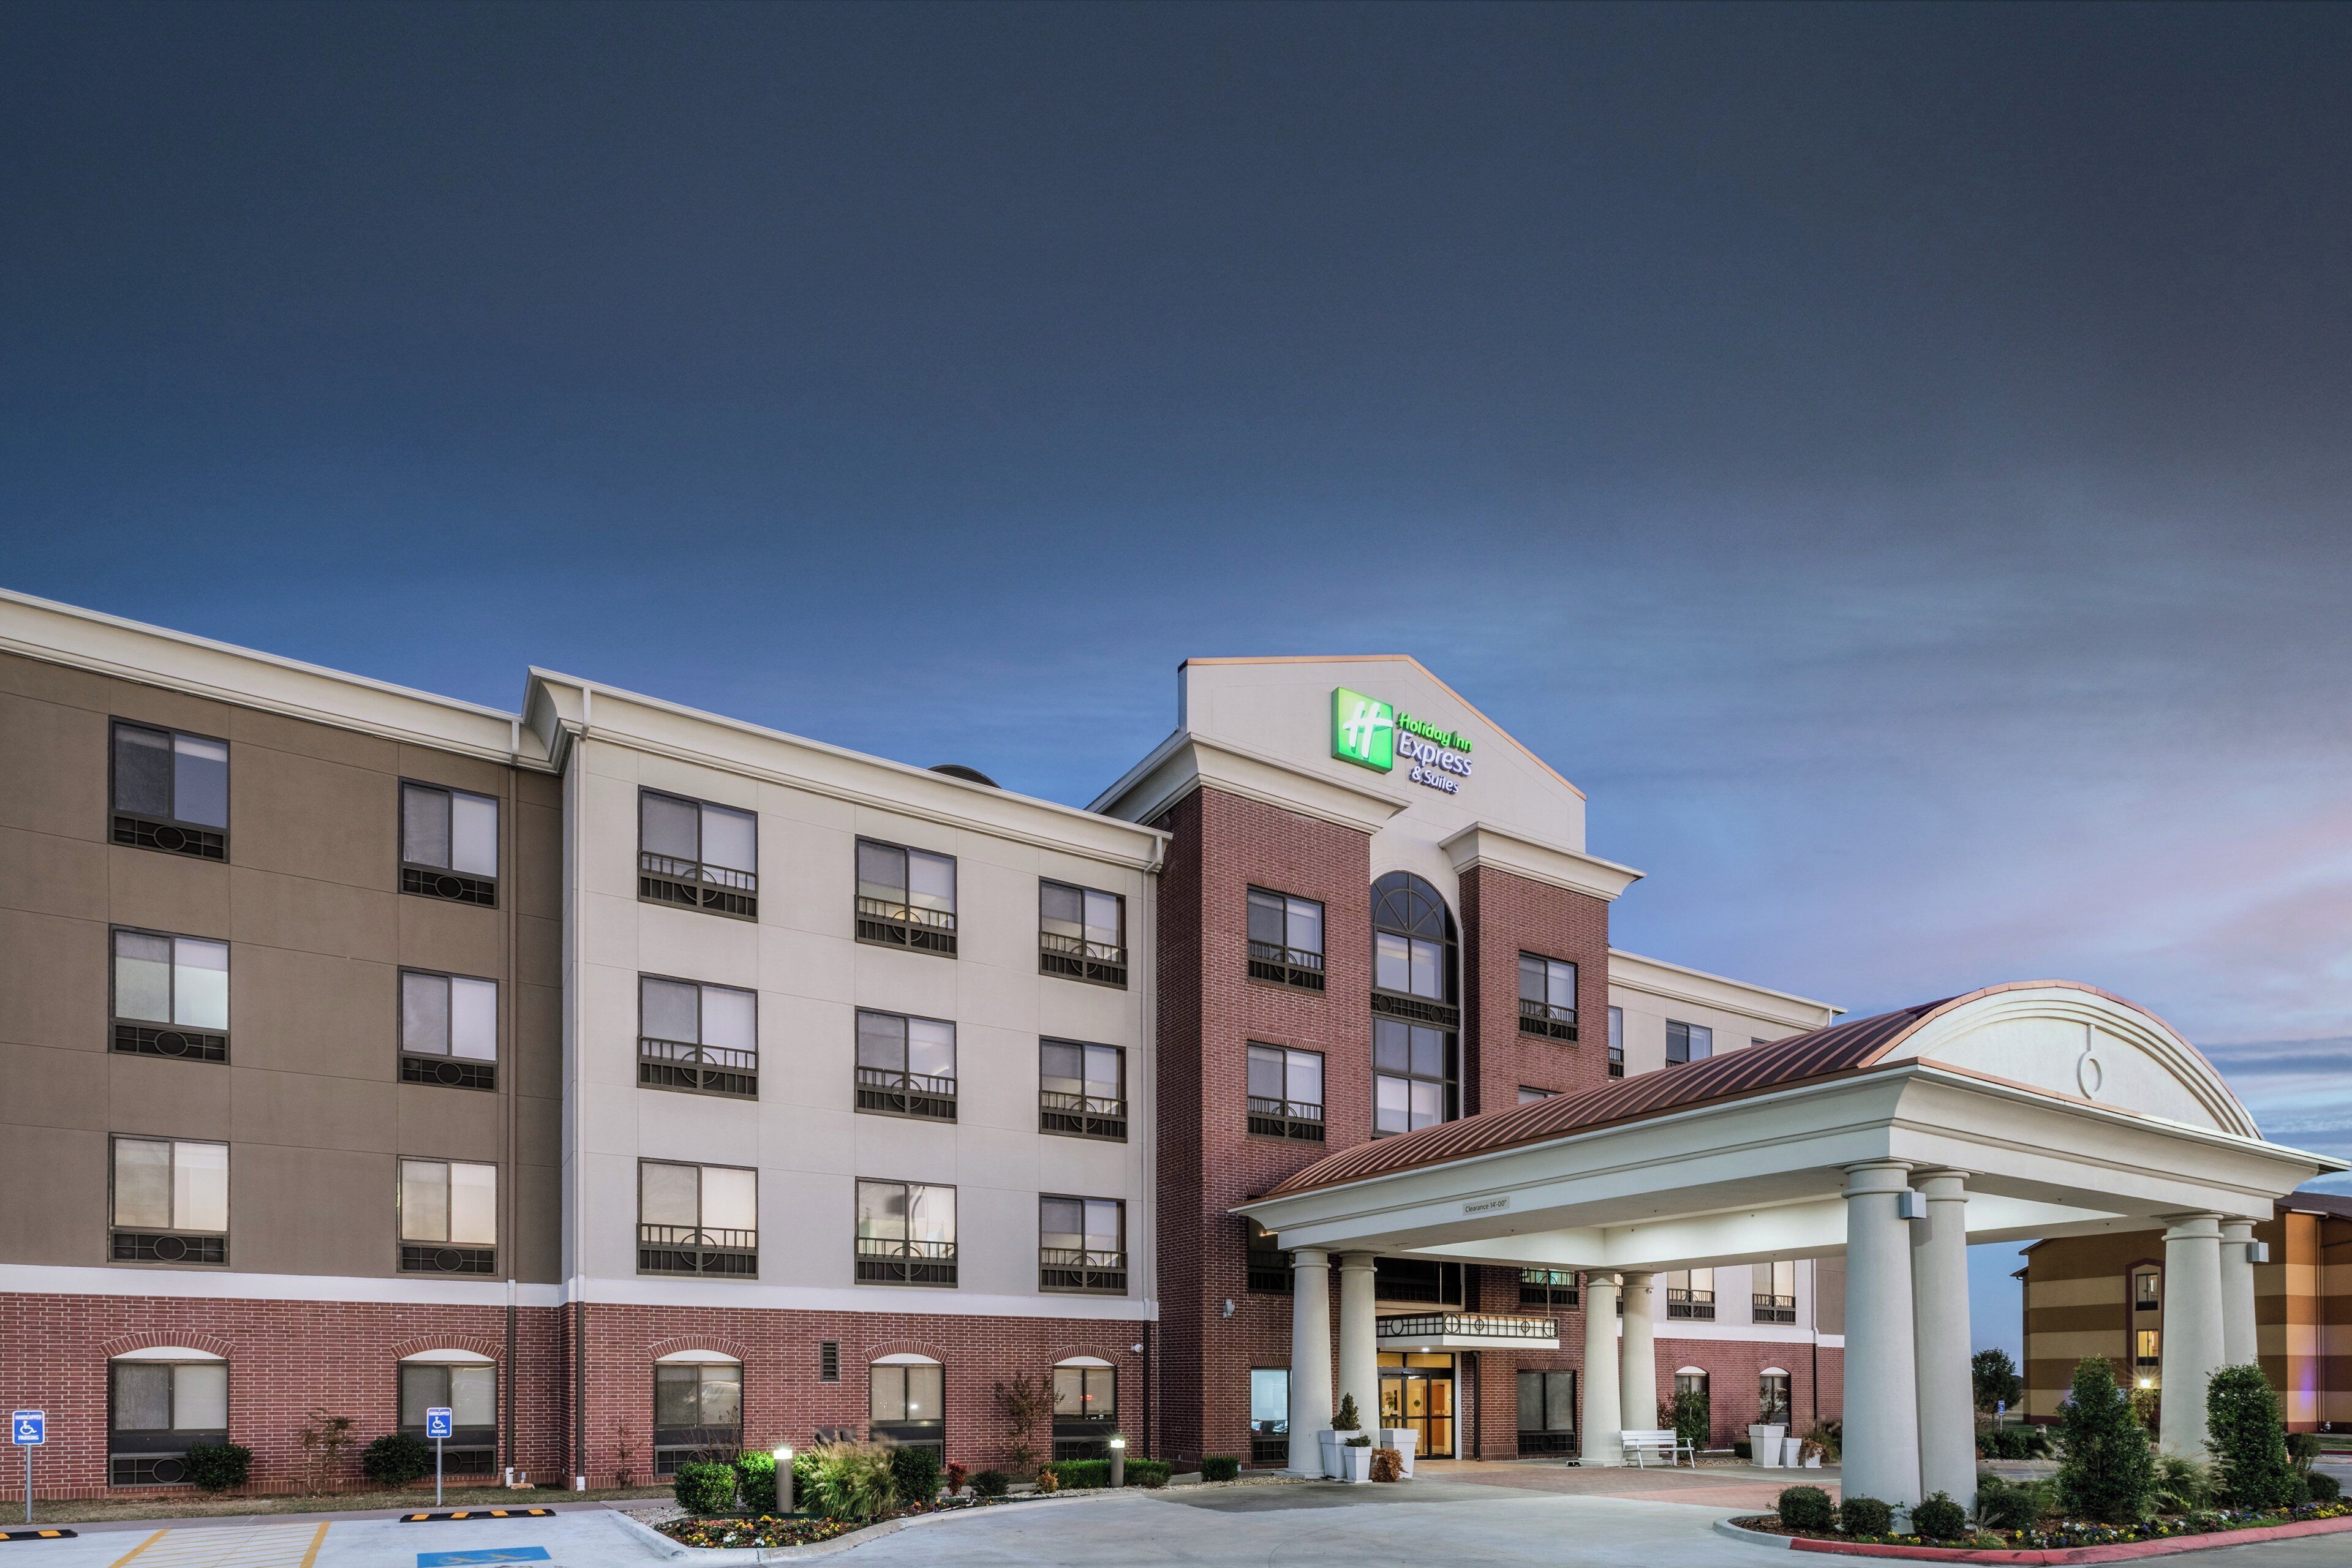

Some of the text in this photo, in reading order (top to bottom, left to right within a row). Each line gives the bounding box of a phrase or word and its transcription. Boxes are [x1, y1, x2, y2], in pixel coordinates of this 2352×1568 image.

[1398, 711, 1473, 752] Holiday Inn
[1398, 731, 1473, 777] Express
[1411, 766, 1460, 793] & Suites
[1465, 1204, 1489, 1213] Clearance
